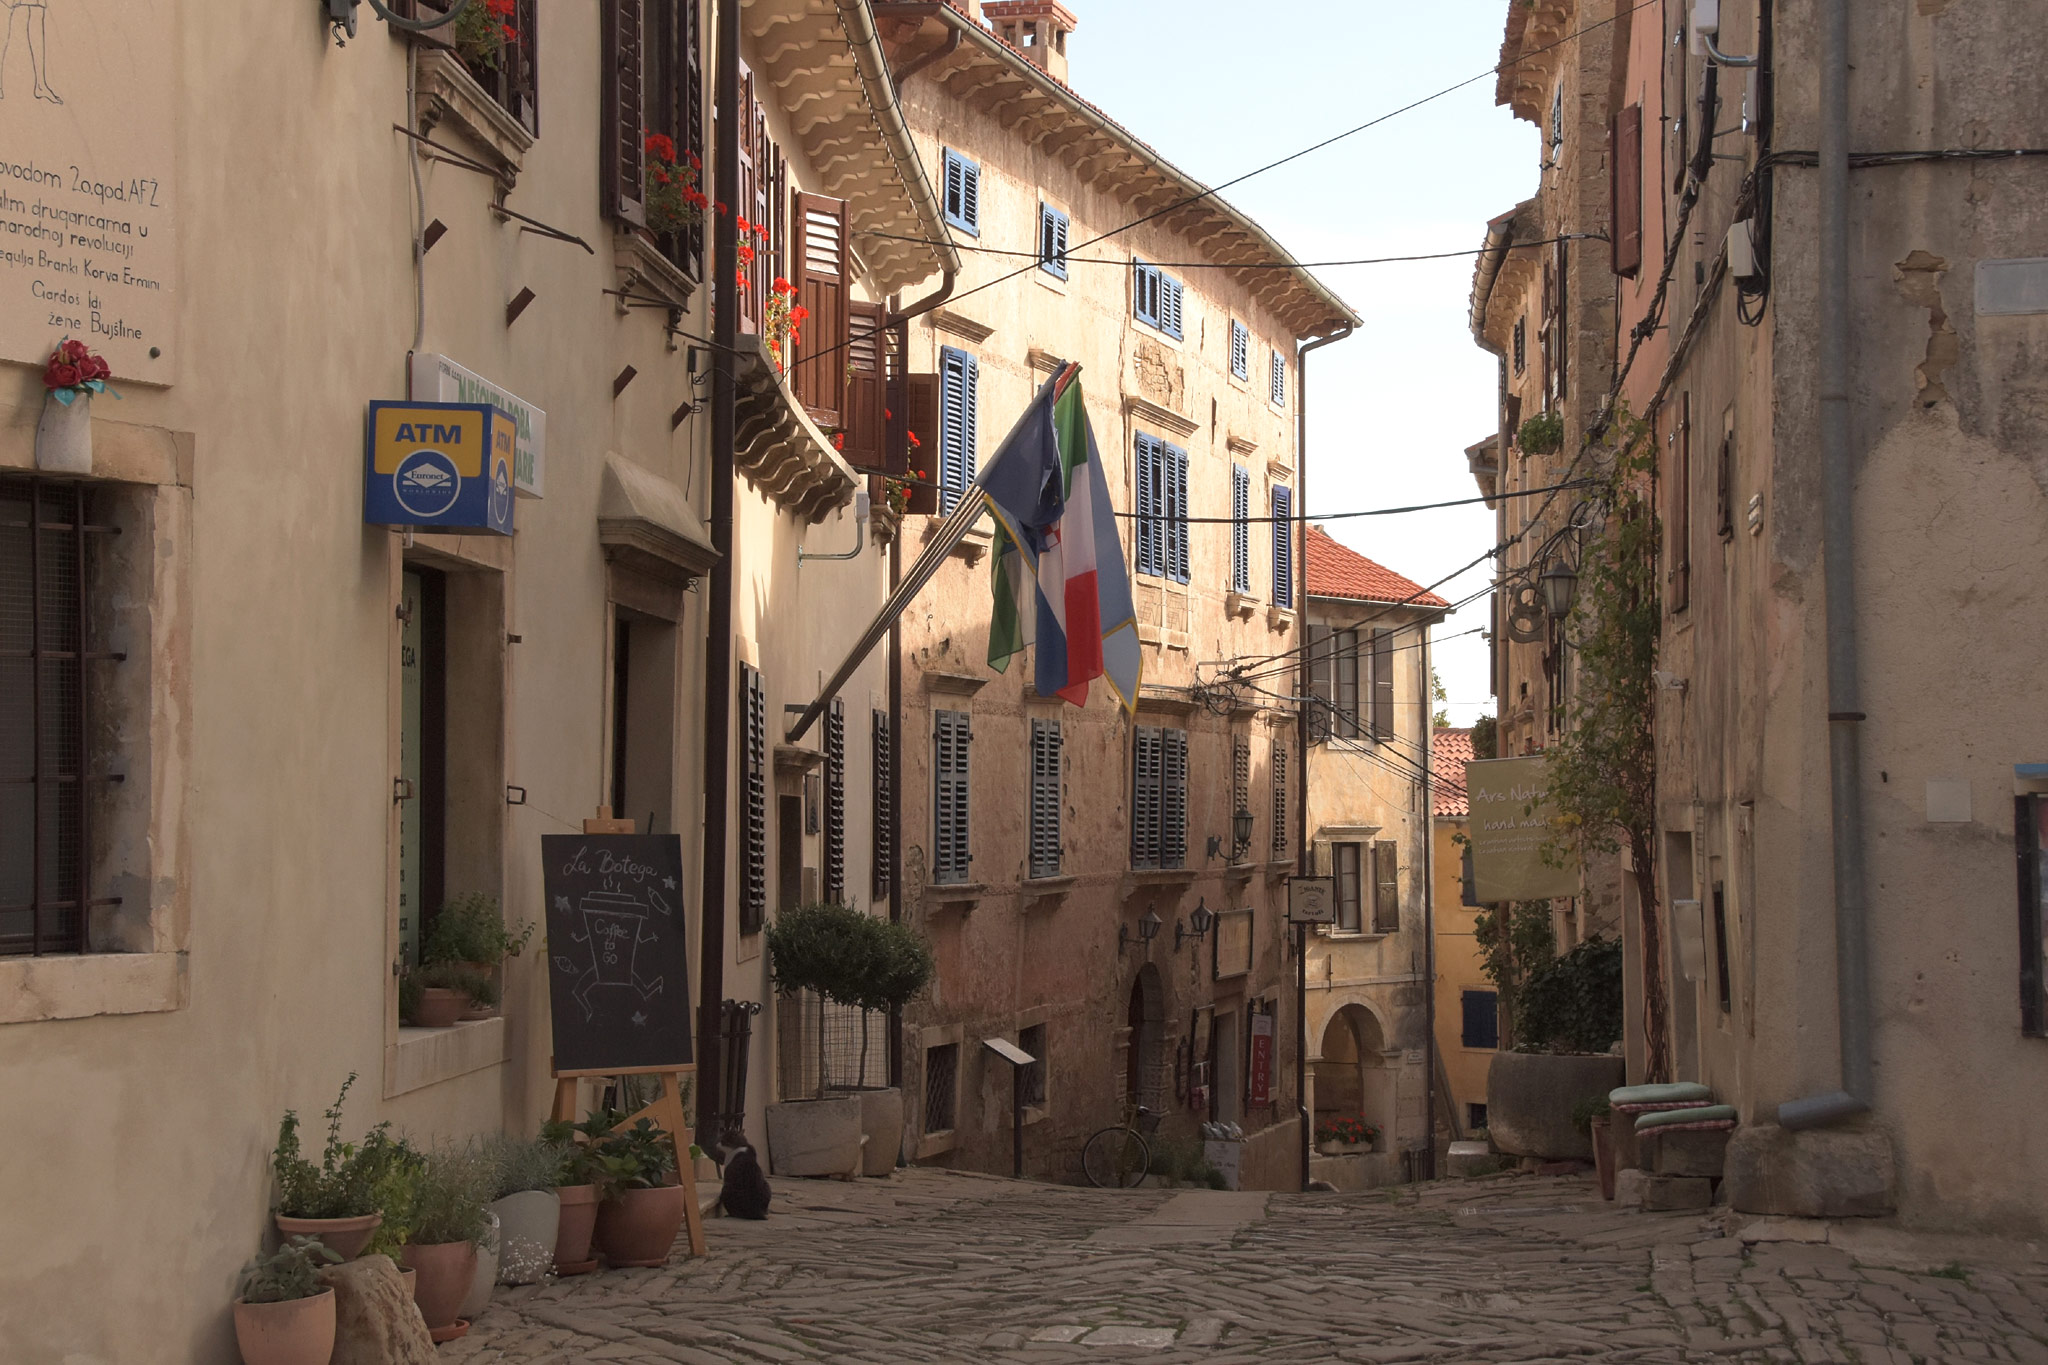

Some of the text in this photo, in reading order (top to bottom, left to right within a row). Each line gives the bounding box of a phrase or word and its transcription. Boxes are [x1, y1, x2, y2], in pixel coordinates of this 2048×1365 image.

[84, 258, 119, 283] Korva
[395, 423, 462, 444] ATM
[496, 429, 511, 455] ATM
[410, 470, 444, 481] Euronet
[514, 447, 535, 486] ARIE
[1476, 787, 1507, 804] Ars
[1483, 816, 1516, 831] hand
[563, 846, 658, 882] La Botega
[594, 919, 630, 940] Coffee
[604, 939, 615, 951] to
[1257, 1039, 1266, 1092] ENTRY
